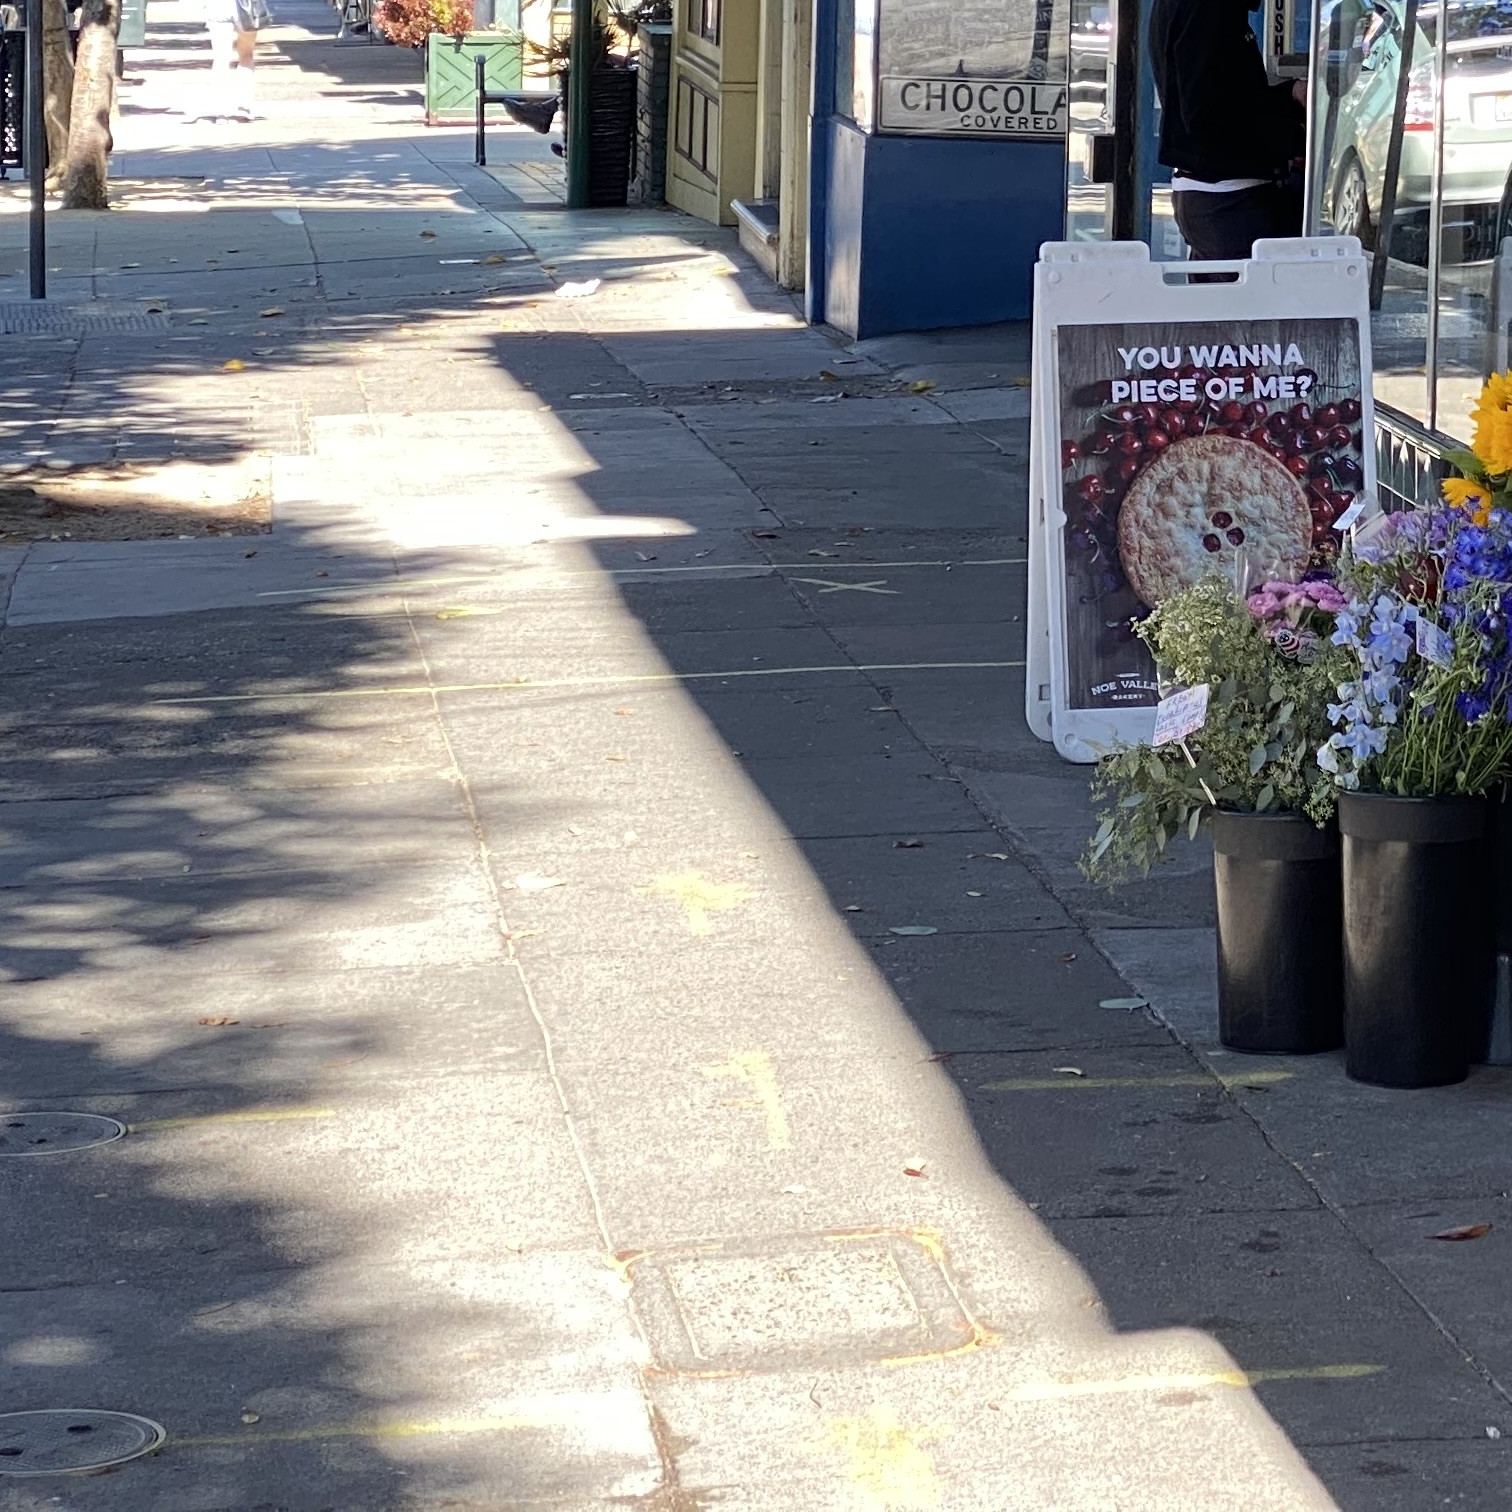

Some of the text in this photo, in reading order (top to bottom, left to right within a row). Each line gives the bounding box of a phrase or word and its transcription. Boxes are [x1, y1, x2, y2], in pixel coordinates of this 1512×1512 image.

[900, 81, 1067, 116] CHOCOLA
[960, 114, 1058, 131] COVERED
[1117, 343, 1304, 370] YOU WANNA
[1111, 375, 1312, 403] PIECE OF ME?
[1091, 681, 1117, 696] NOE
